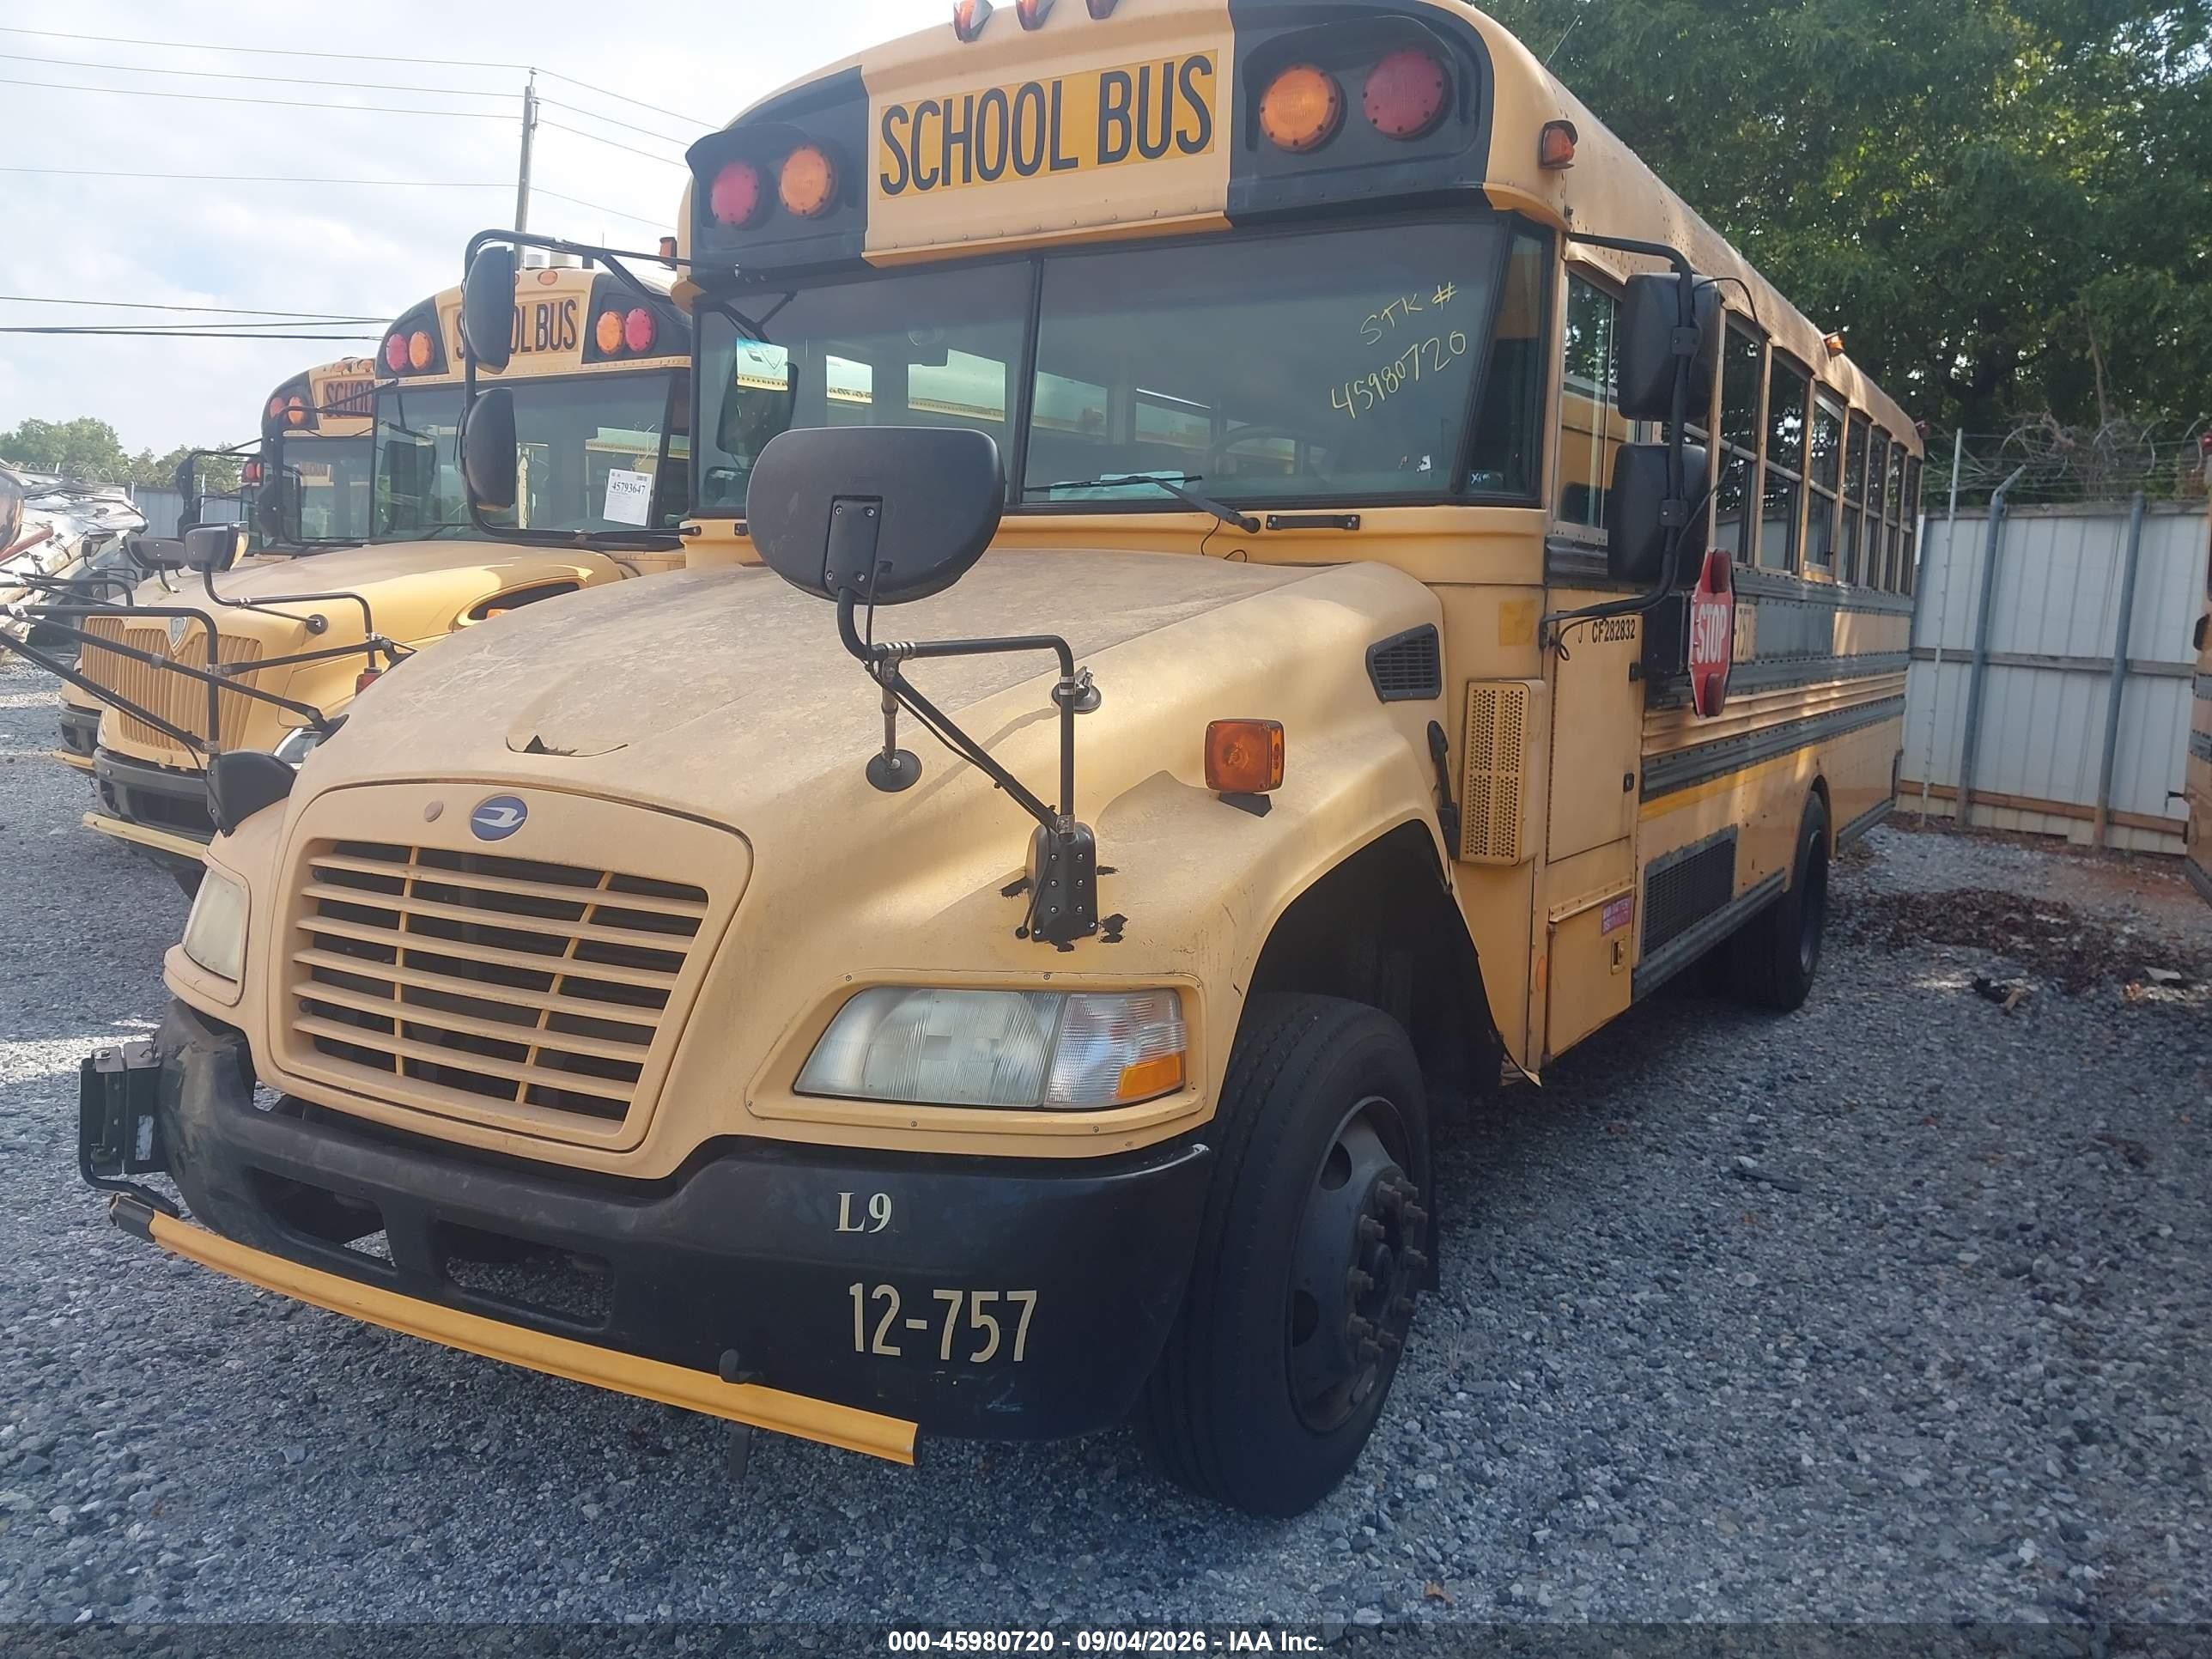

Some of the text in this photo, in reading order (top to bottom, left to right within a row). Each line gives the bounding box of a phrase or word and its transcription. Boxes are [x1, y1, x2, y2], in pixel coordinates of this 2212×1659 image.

[880, 55, 1212, 196] SCHOOL BUS
[456, 299, 577, 359] SOL BUS
[1360, 282, 1458, 345] STK #
[1331, 331, 1467, 419] 45980720
[611, 482, 646, 495] 45793647
[1591, 619, 1636, 644] CF282832
[1695, 604, 1727, 665] STOP
[835, 1192, 892, 1233] L9
[849, 1283, 1037, 1363] 12-757
